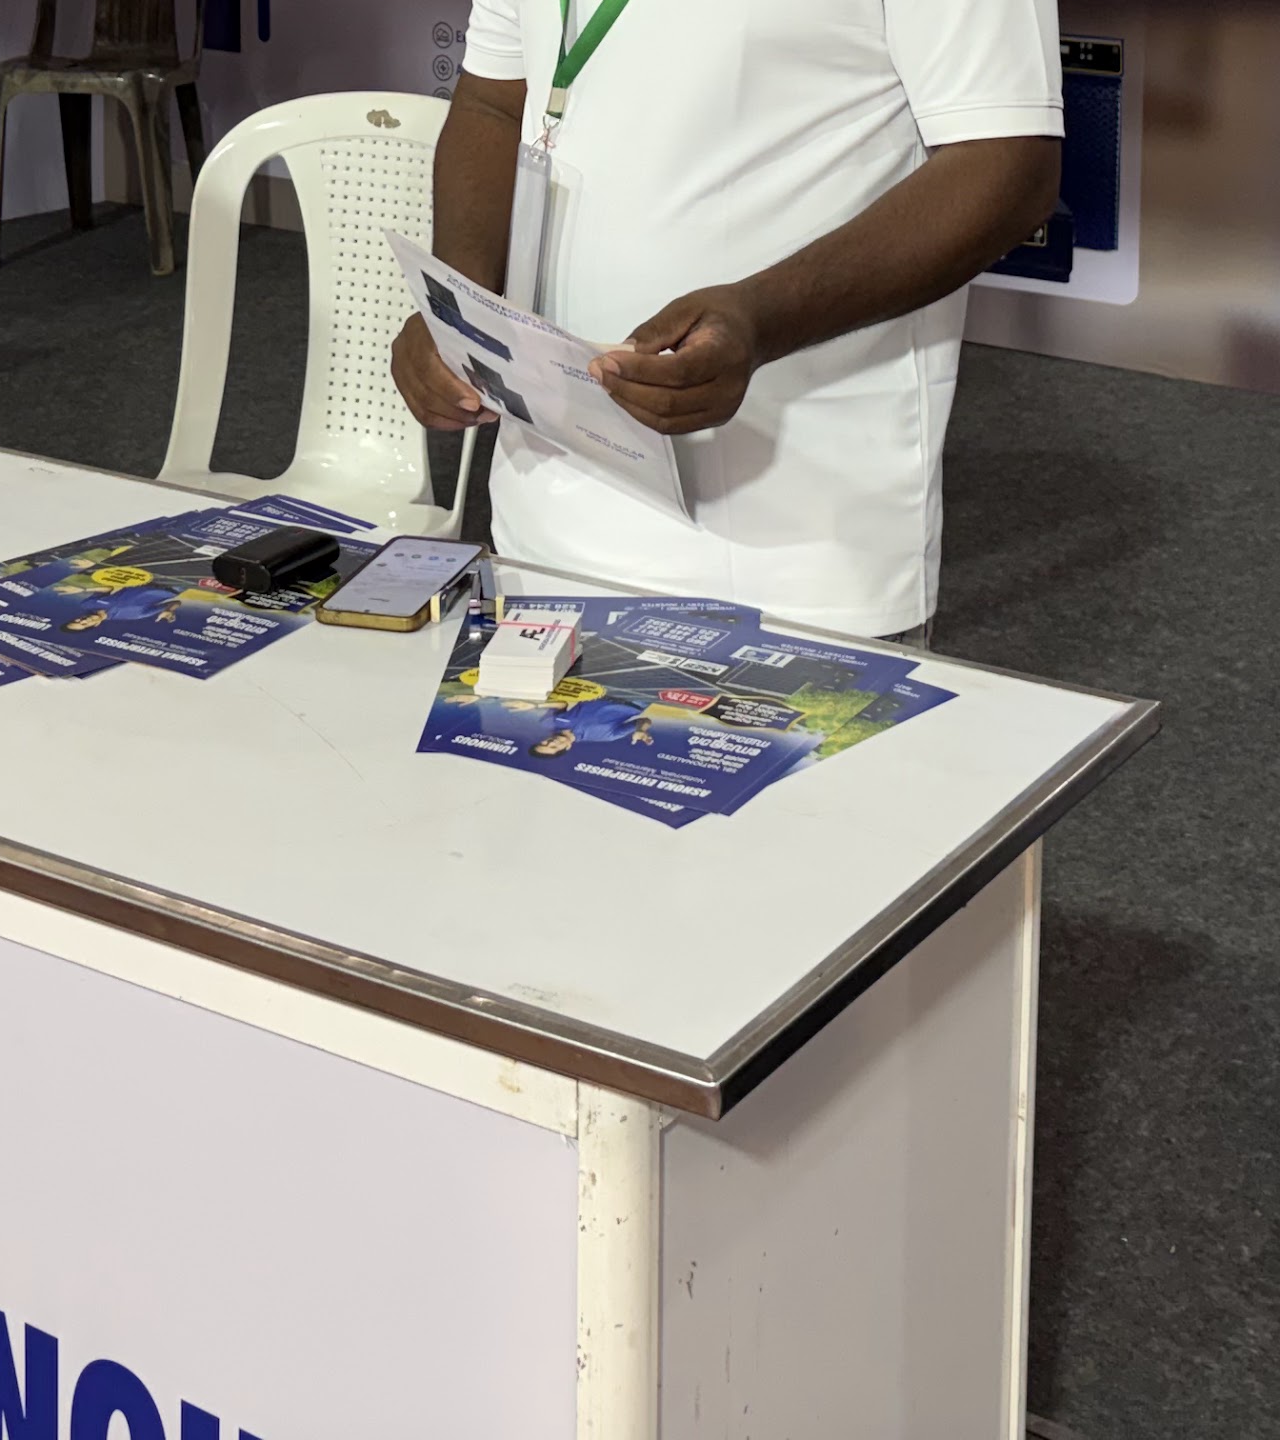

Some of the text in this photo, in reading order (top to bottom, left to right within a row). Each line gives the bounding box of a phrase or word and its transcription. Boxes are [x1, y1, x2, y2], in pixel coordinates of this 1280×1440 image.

[95, 636, 208, 667] ASHOKA ENTERPRISES
[451, 735, 518, 755] LUMINOUS
[574, 762, 659, 787] ENTERPRISES
[659, 780, 712, 797] ASHOKA
